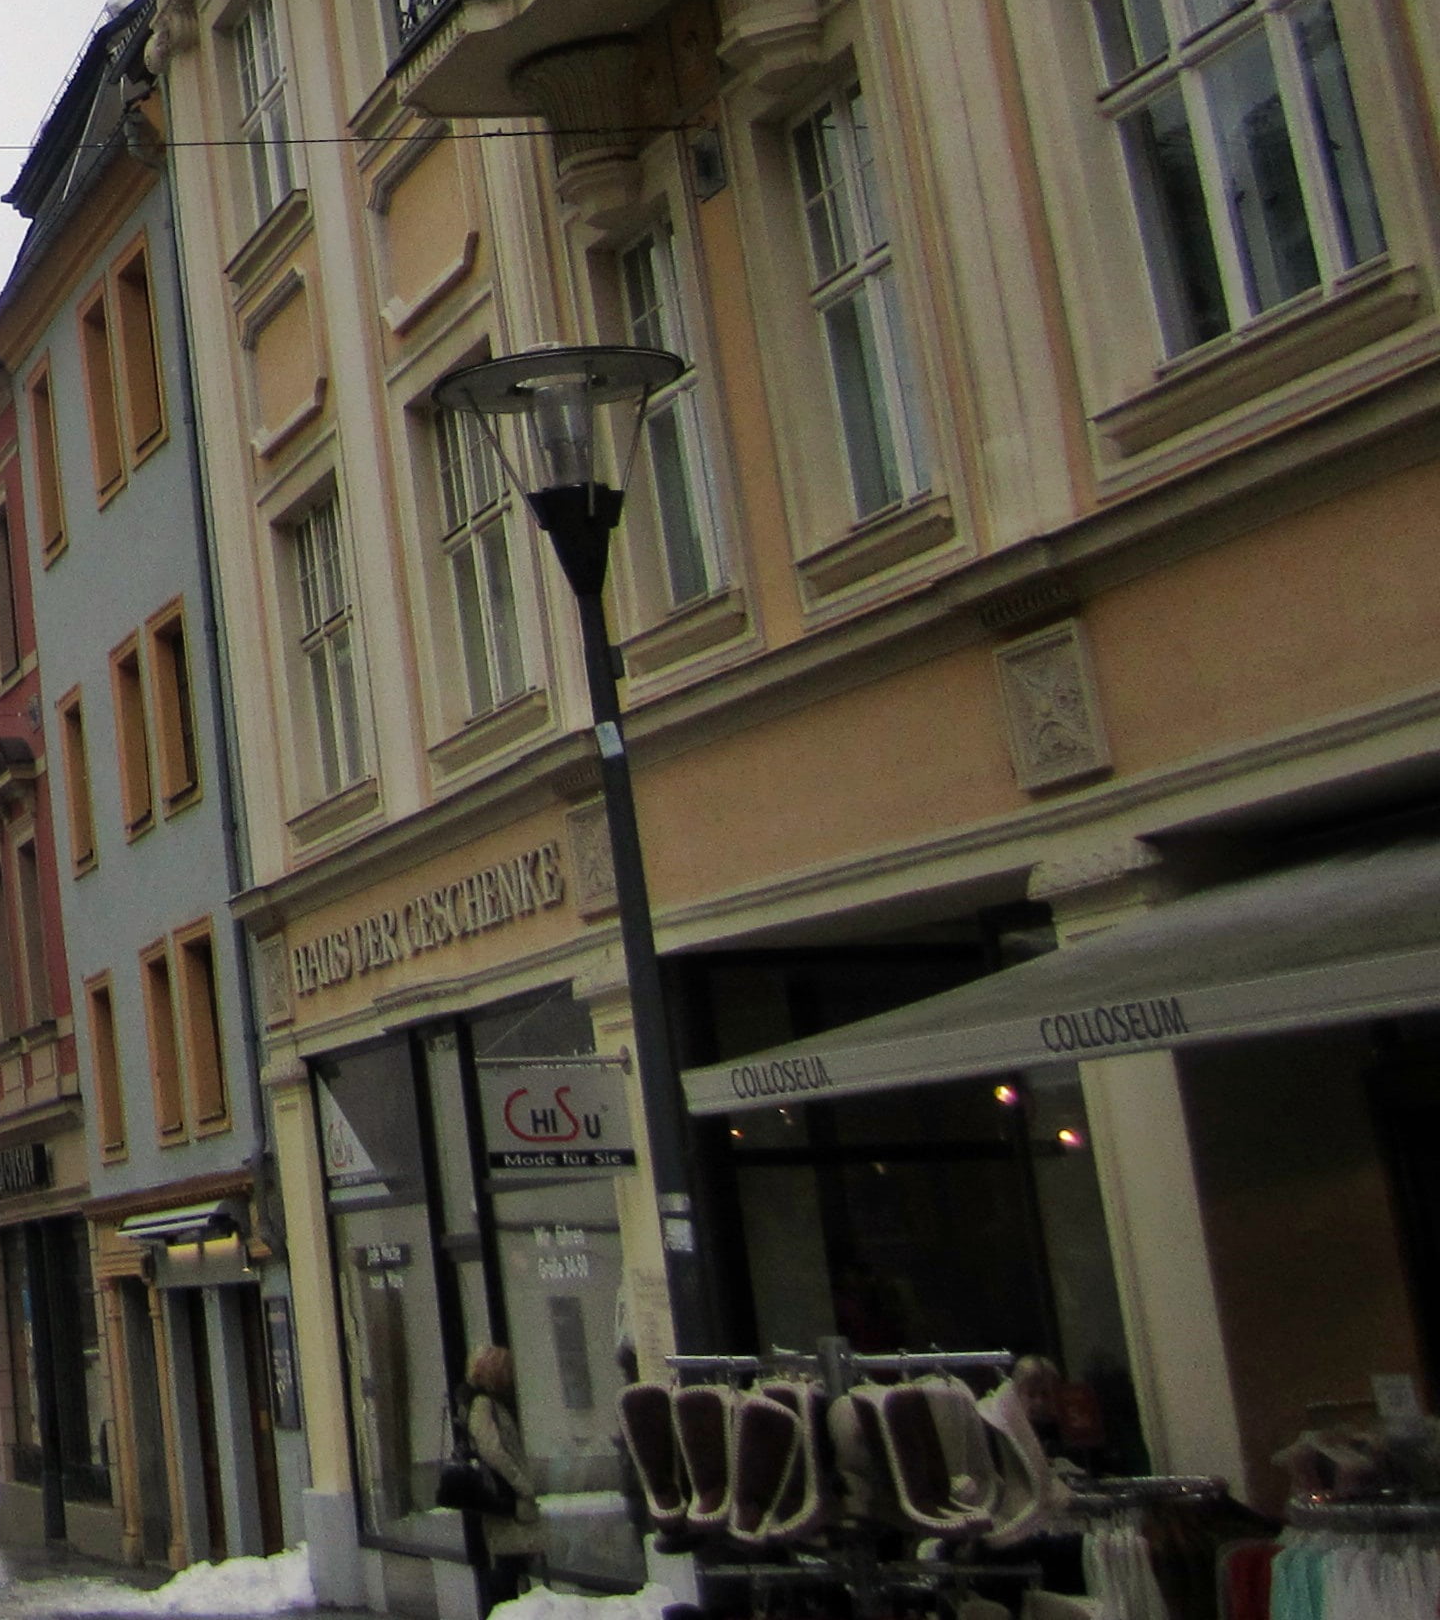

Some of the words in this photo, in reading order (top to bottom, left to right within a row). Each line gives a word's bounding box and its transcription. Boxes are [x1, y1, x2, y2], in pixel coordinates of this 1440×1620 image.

[291, 931, 353, 997] HAUS
[350, 910, 400, 974] DER
[400, 840, 566, 957] GESCHENKE
[1039, 996, 1190, 1053] COLLOSEUM
[504, 1153, 558, 1167] Mode
[563, 1151, 588, 1165] für
[594, 1151, 621, 1164] Sie
